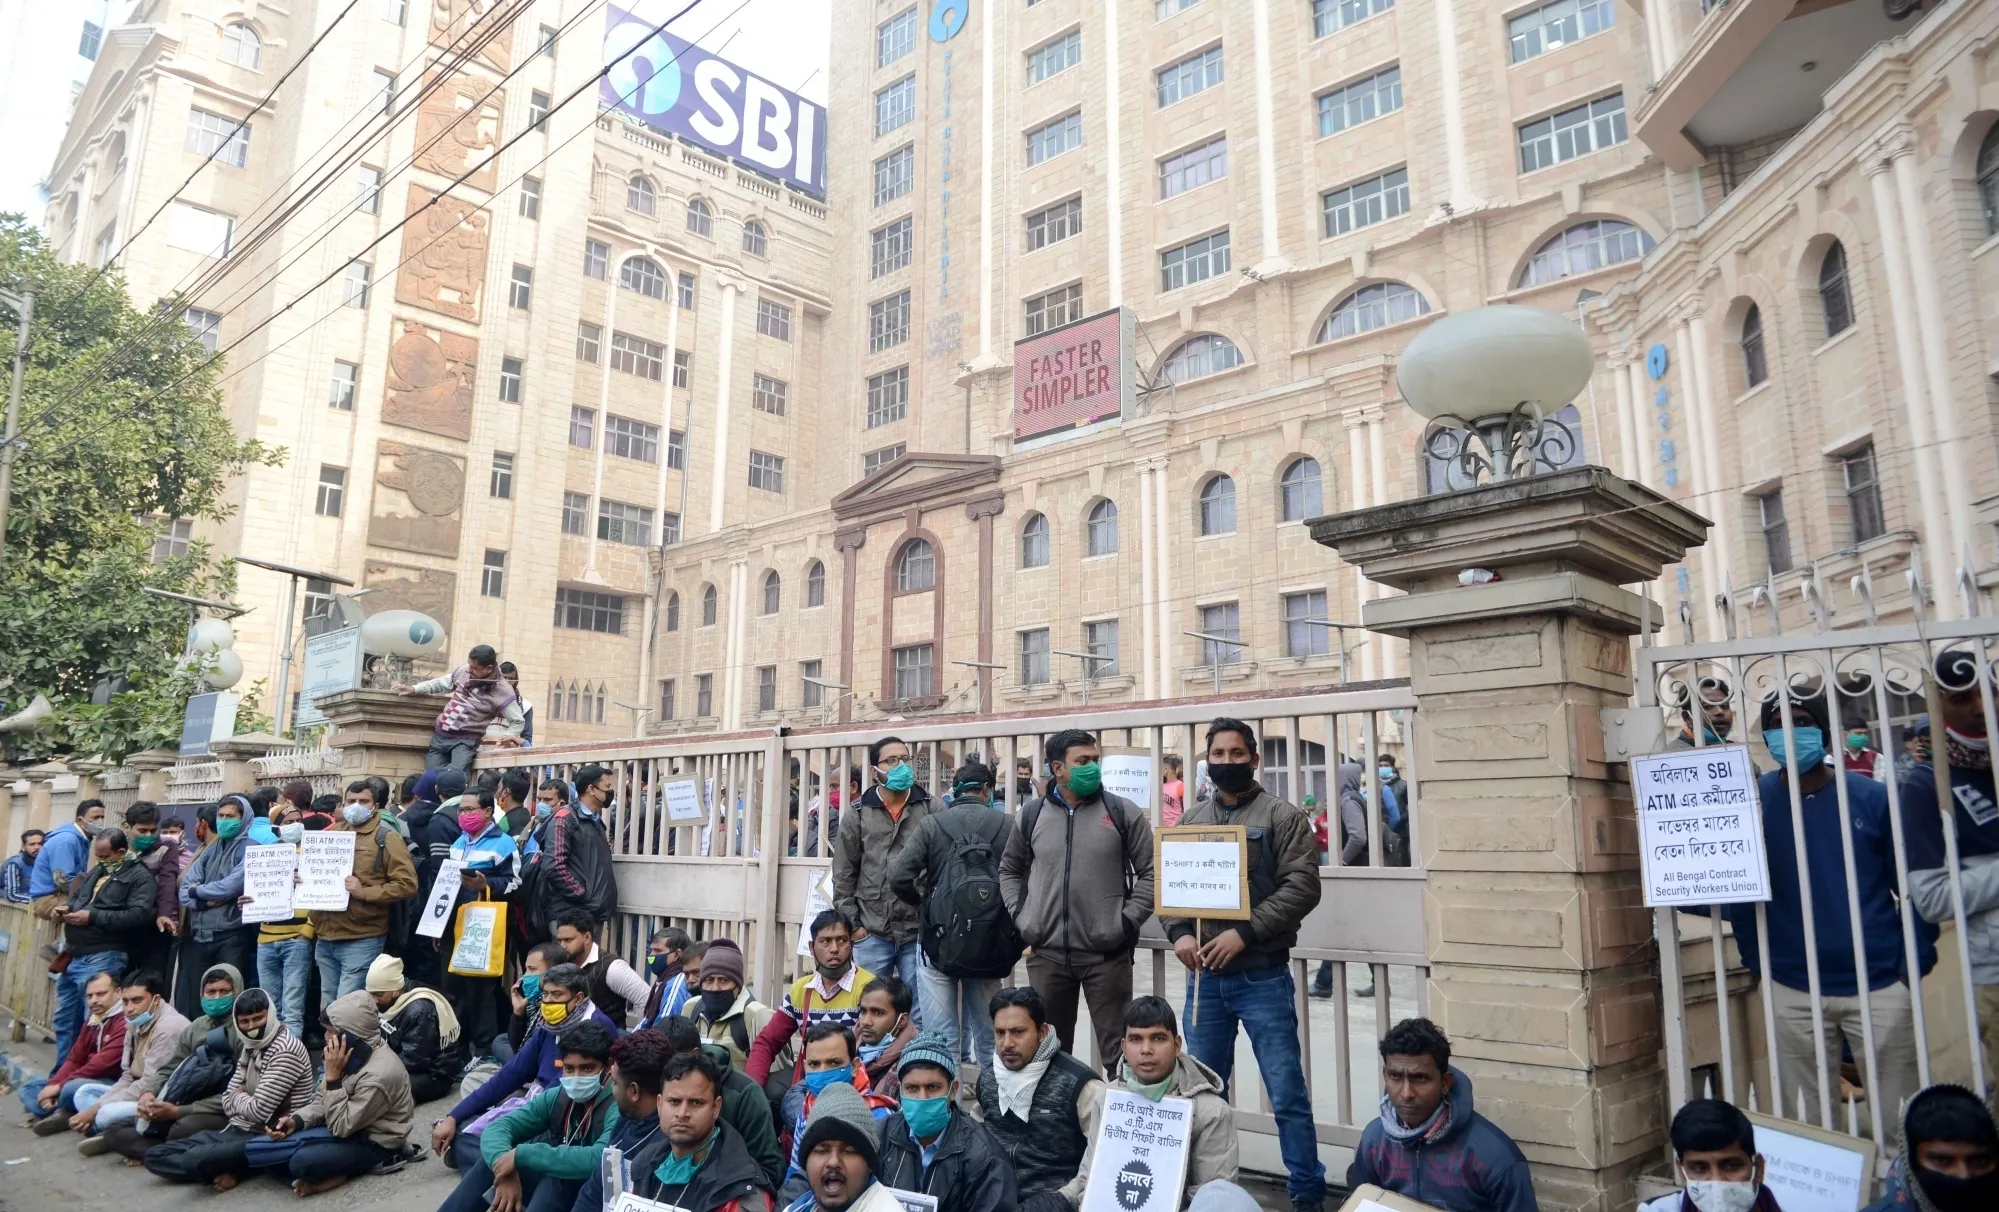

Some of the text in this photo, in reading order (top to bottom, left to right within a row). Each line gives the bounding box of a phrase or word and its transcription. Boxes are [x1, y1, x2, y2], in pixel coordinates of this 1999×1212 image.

[688, 59, 815, 185] SBI
[1030, 339, 1103, 382] FASTER
[1022, 364, 1111, 415] SIMPLER
[1650, 761, 1733, 784] অবিলম্বে SBI
[1647, 784, 1746, 811] ATM এর কর্মীদের
[1657, 814, 1740, 835] নভেম্বর মাসের
[305, 837, 318, 845] SBI
[1654, 844, 1685, 861] বেতন
[1688, 837, 1717, 859] দিতে
[246, 851, 259, 859] SBI
[260, 850, 275, 858] ATM
[1663, 868, 1747, 884] All Bengal Contract
[1655, 881, 1758, 898] Security Workers Union
[1104, 1124, 1182, 1149] দ্বিতীয় শিফট বাতিল
[1132, 1146, 1150, 1158] করা
[1120, 1171, 1152, 1188] চলবে
[1125, 1190, 1139, 1204] না
